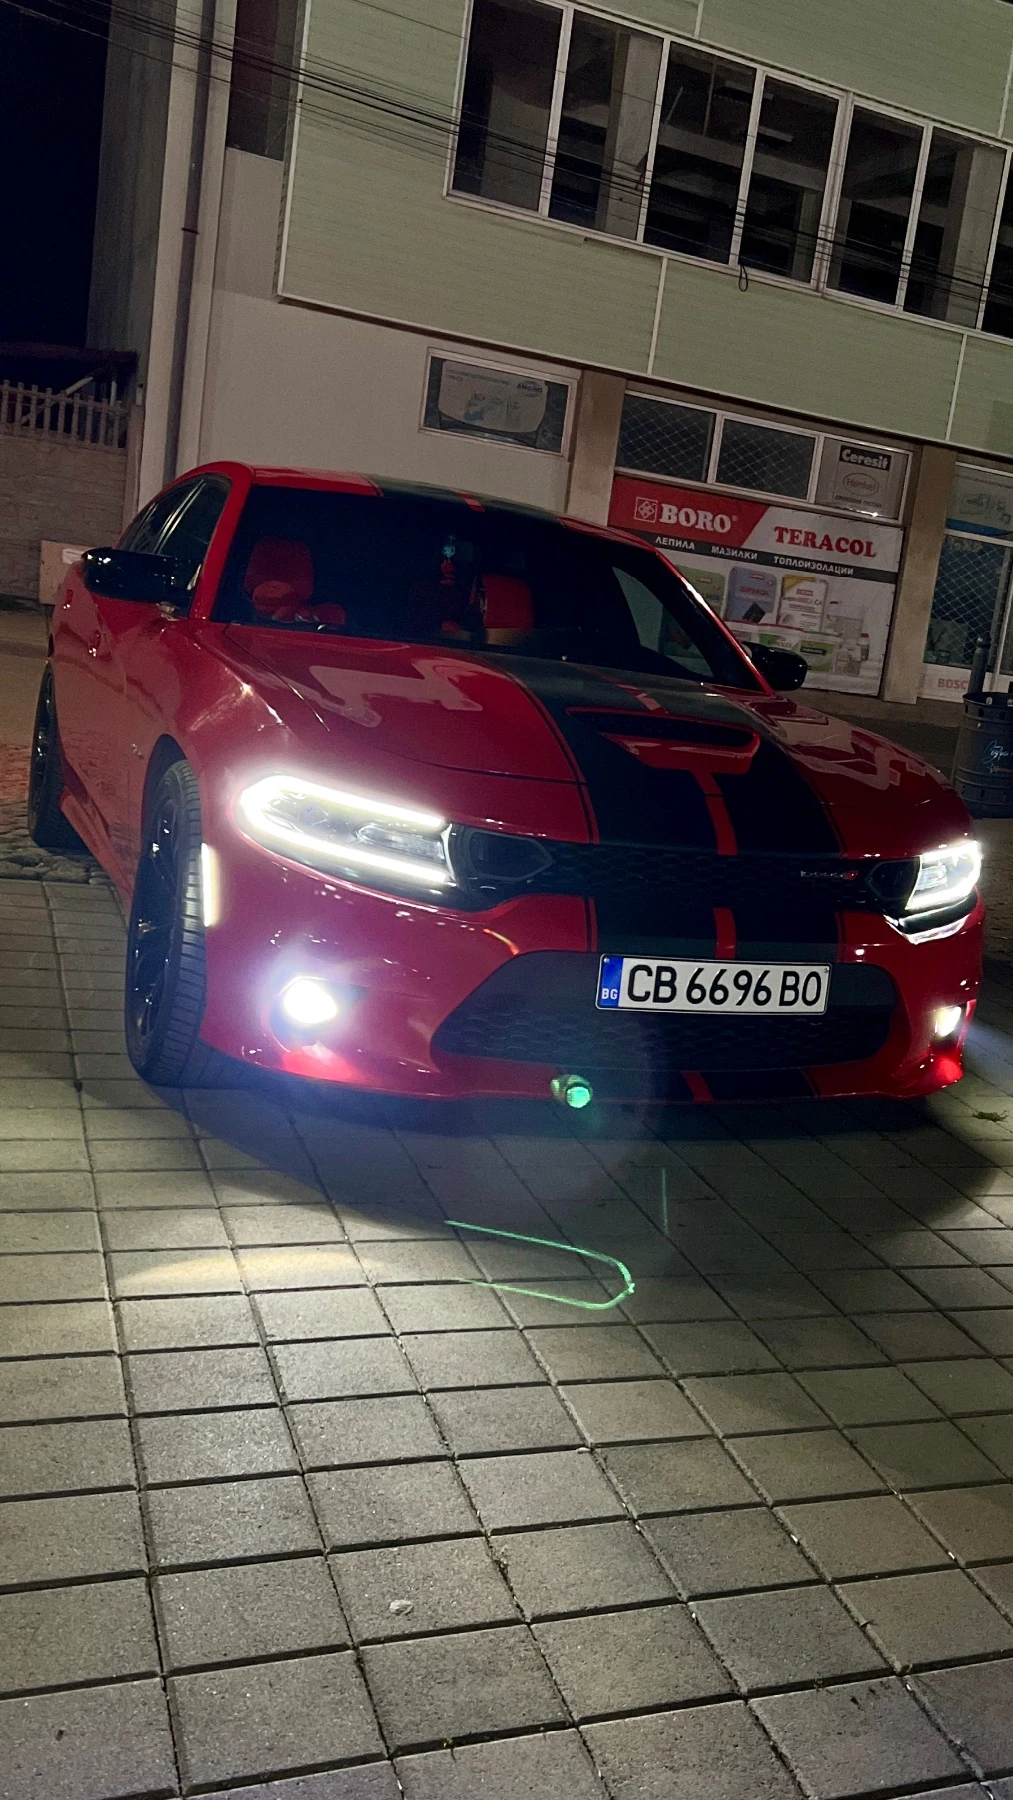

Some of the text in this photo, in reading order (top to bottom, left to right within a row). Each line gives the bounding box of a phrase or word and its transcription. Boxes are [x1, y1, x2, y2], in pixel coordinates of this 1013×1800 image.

[841, 449, 888, 469] Ceresit
[774, 526, 876, 558] TERACOL
[655, 536, 854, 575] ЛЕПИЛА МАЗИЛКИ ТОПЛОИЗОЛАЦИИ
[937, 678, 969, 690] BOSC
[601, 988, 618, 1000] BG
